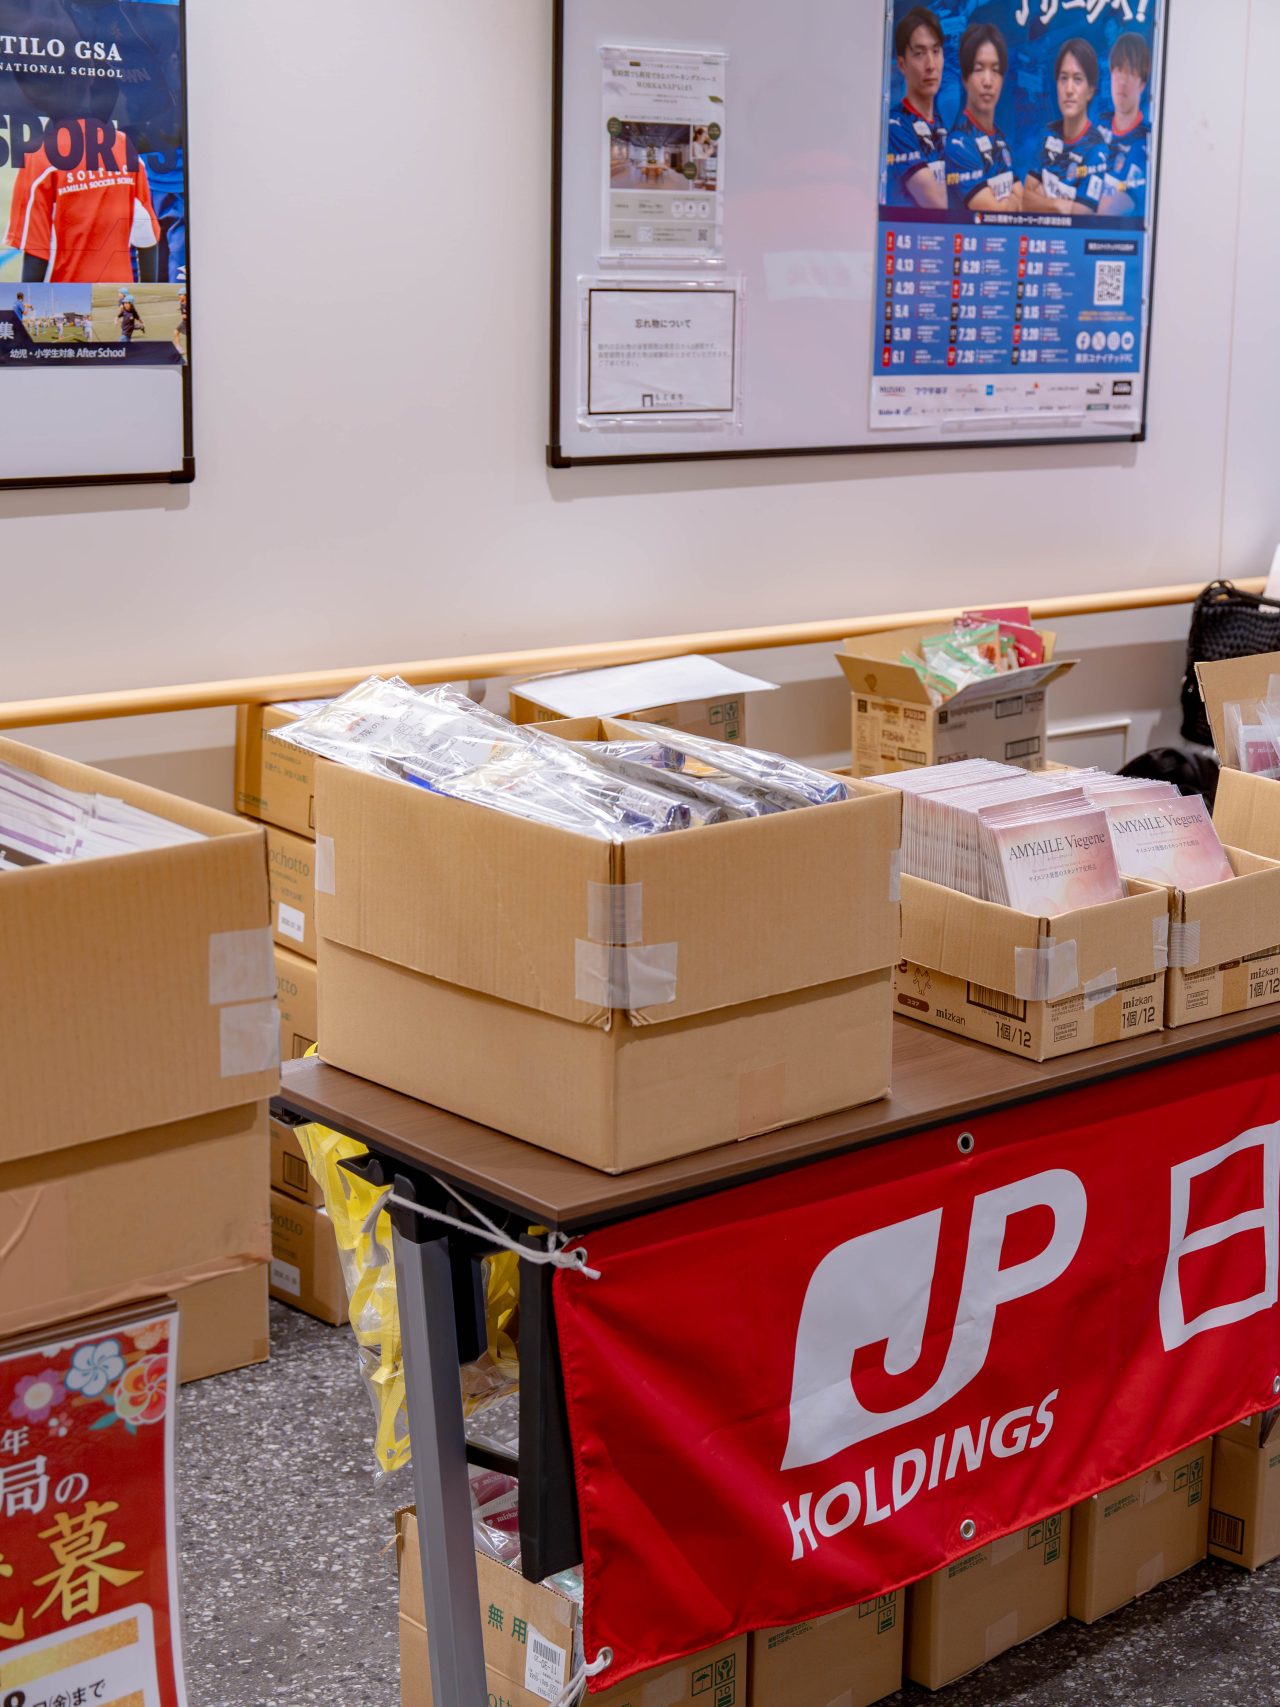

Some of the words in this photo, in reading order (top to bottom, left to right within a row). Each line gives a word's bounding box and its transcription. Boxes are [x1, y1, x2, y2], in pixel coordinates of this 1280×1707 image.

[1, 35, 65, 57] TILO
[75, 41, 122, 61] GSA
[71, 67, 123, 78] SCHOOL
[0, 322, 15, 340] 集
[635, 319, 692, 329] 忘れ物について
[77, 348, 98, 358] After
[99, 348, 126, 358] School
[1113, 817, 1164, 834] AMYAILE
[1163, 814, 1202, 828] Viegene
[1009, 837, 1064, 861] AMYAILE
[1065, 832, 1105, 850] Viegene
[1250, 966, 1279, 981] mizkan
[1249, 978, 1280, 999] 1個/12
[1123, 995, 1153, 1010] mizkan
[936, 1008, 966, 1026] mizkan
[1122, 1006, 1155, 1029] 1個/12
[995, 1021, 1032, 1049] 1個/12
[781, 1168, 1086, 1469] JP
[2, 1426, 29, 1456] 年
[783, 1388, 1059, 1561] HOLDINGS
[488, 1603, 528, 1645] 無用
